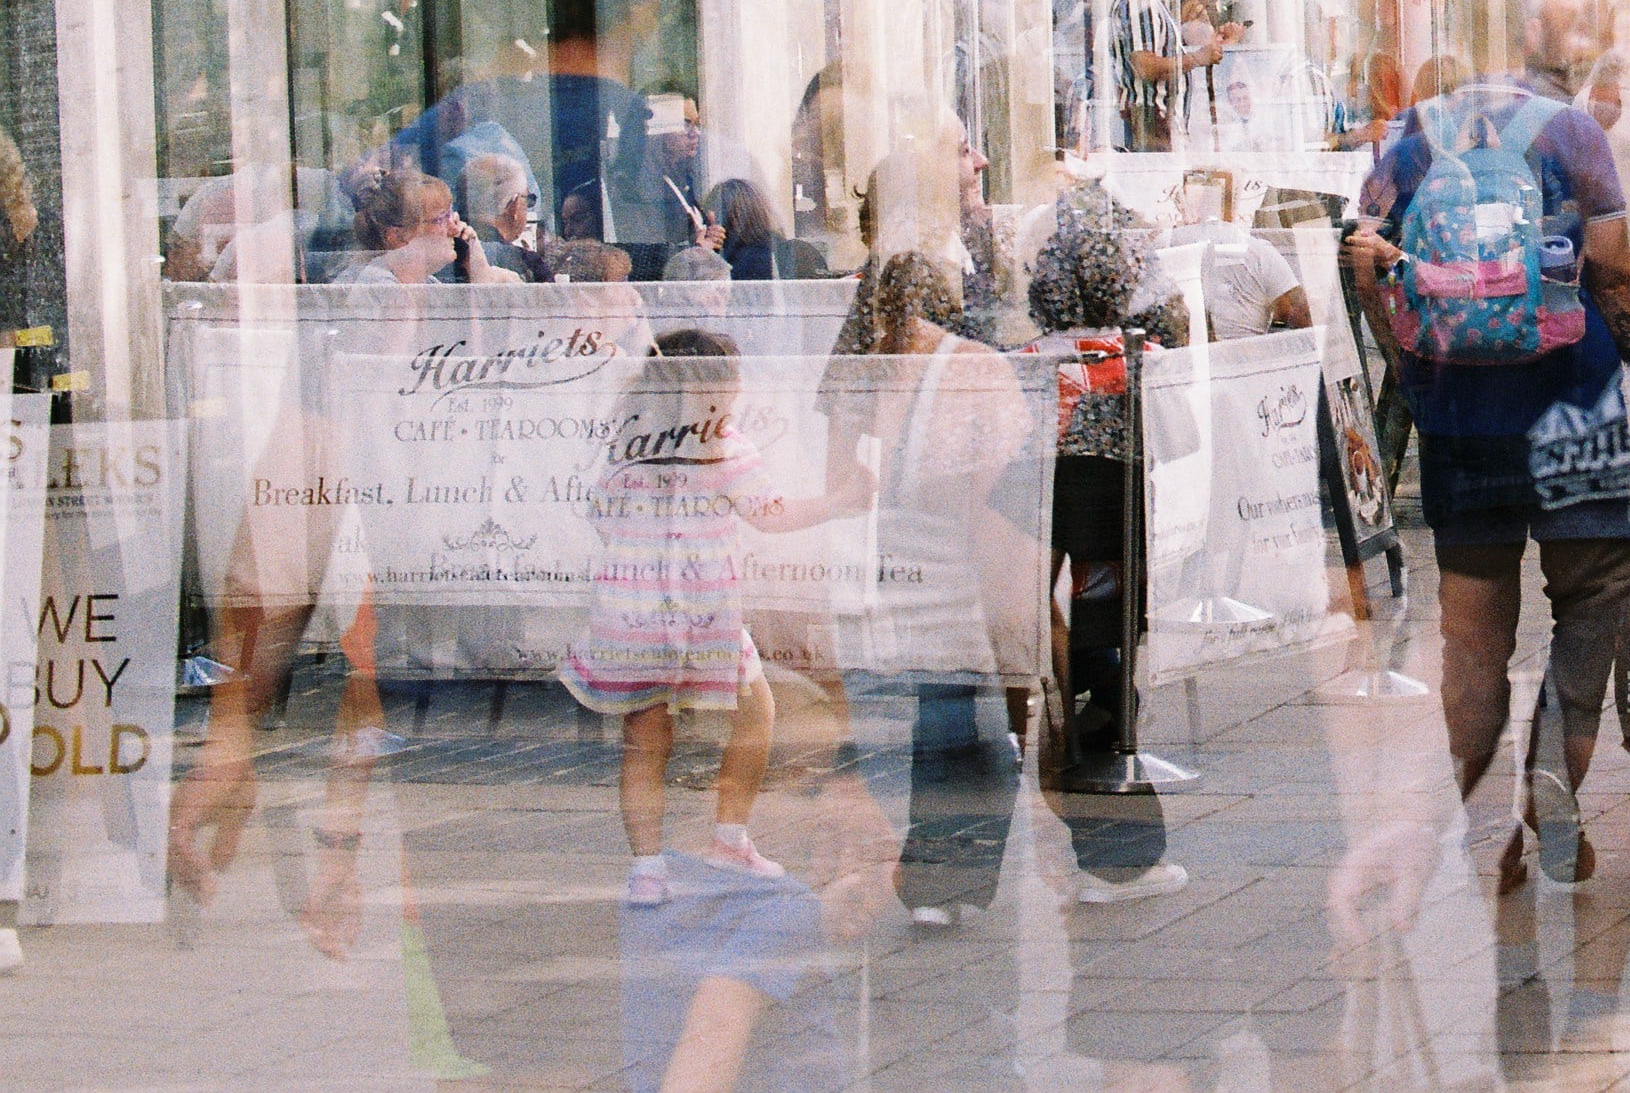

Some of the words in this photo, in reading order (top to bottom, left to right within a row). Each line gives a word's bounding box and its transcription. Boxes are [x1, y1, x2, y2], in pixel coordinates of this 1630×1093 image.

[397, 327, 617, 398] Harriets
[474, 416, 610, 441] TEAROOMS
[253, 476, 394, 508] Breakfast,
[406, 475, 494, 505] Lunch
[504, 474, 528, 504] &
[722, 551, 864, 582] Afternoon
[876, 553, 924, 585] Tea
[30, 723, 150, 777] OLD
